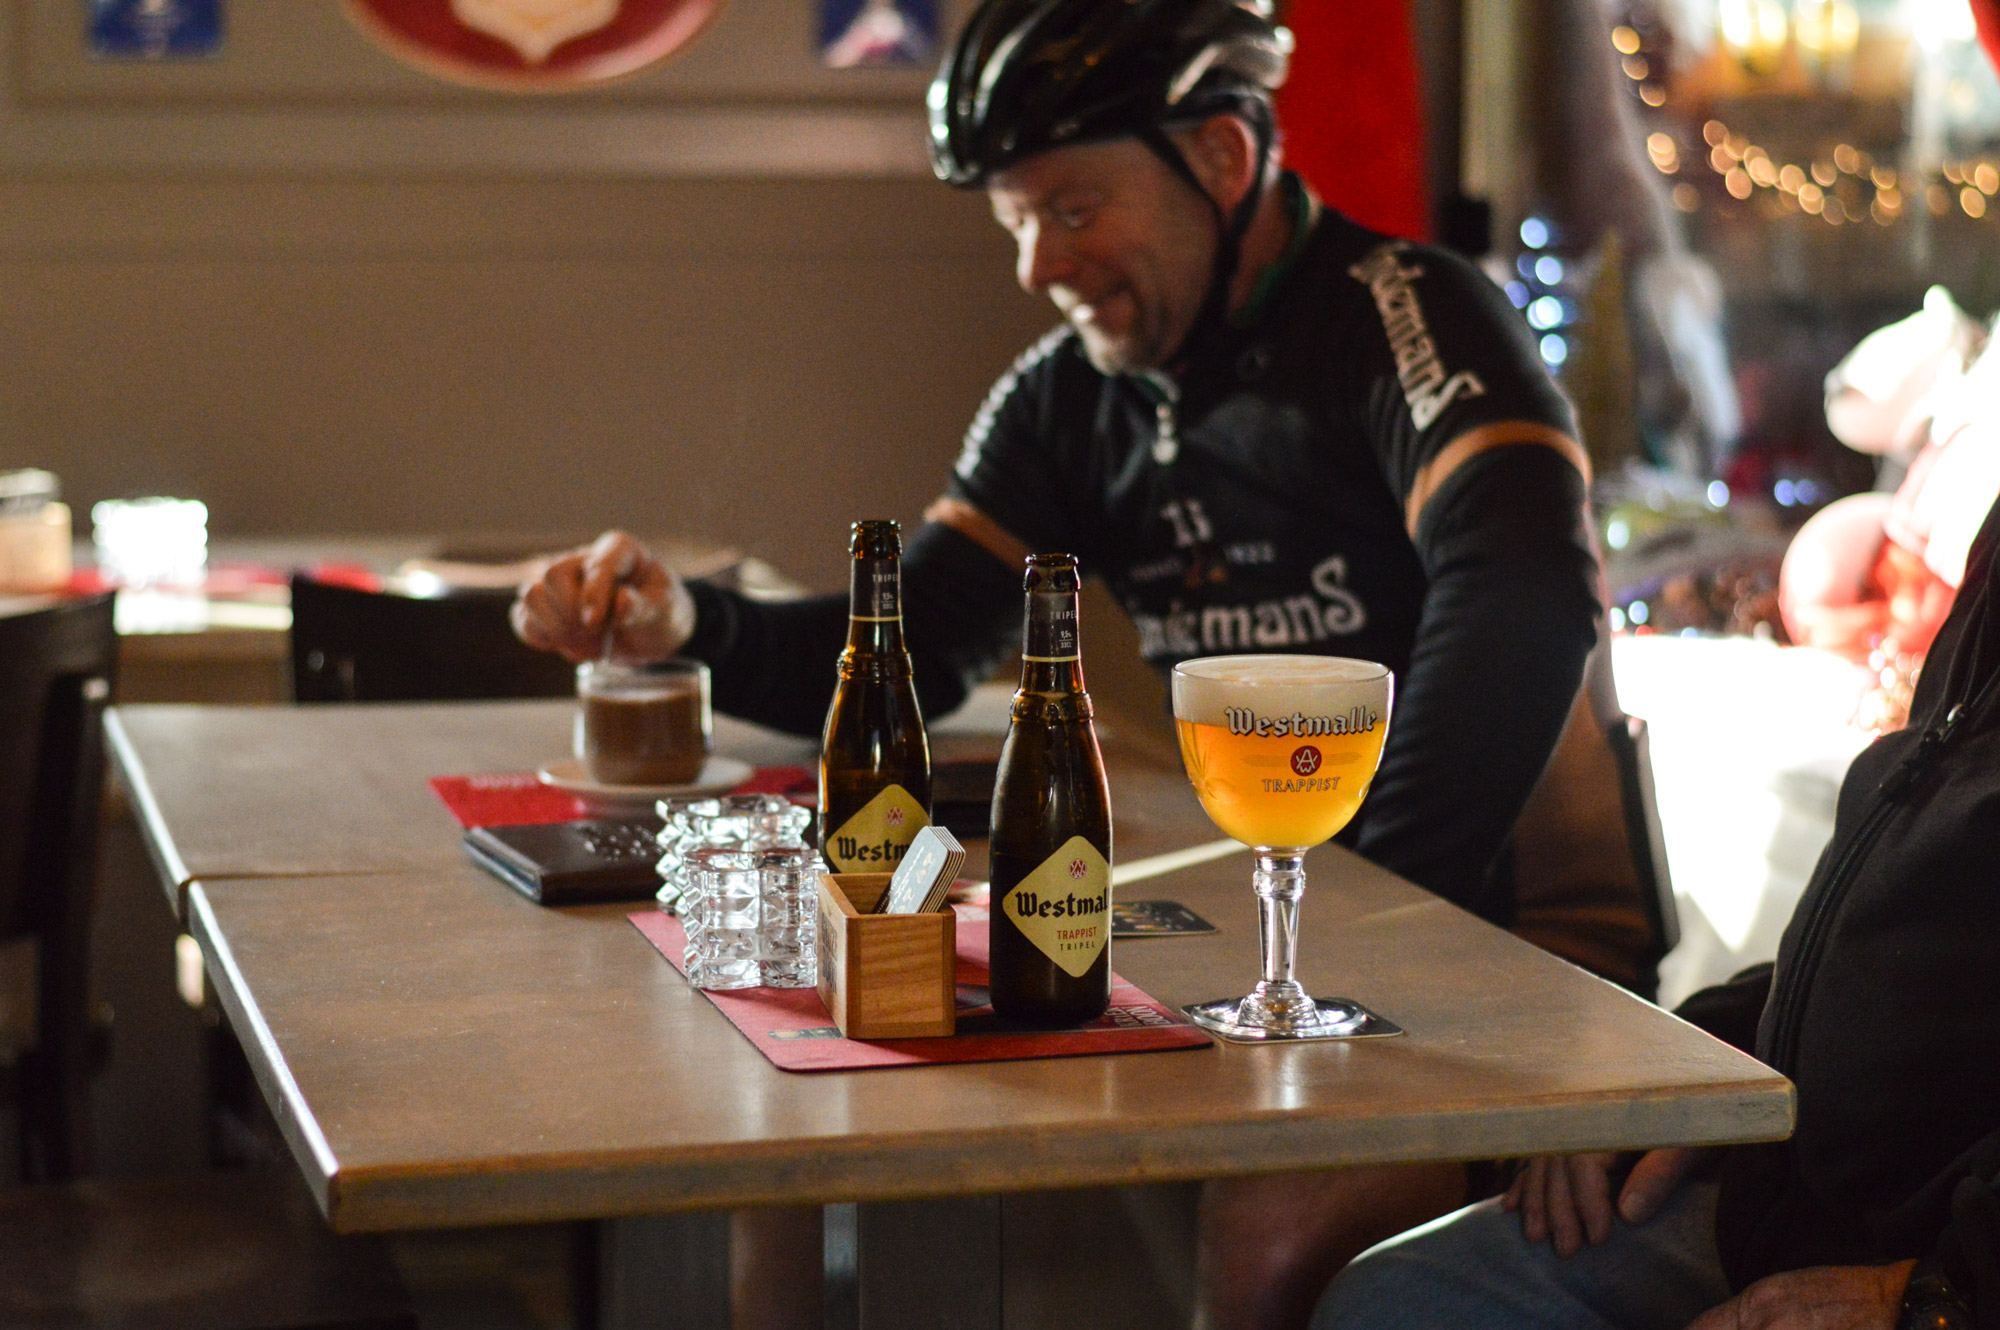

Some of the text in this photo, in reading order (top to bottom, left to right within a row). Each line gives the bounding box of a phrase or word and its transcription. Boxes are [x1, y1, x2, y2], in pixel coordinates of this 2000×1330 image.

[1225, 705, 1377, 738] Westmalle
[1262, 777, 1341, 793] TRAPPIST
[1056, 926, 1097, 940] TRAPPIST
[1060, 941, 1095, 952] TRIPEL
